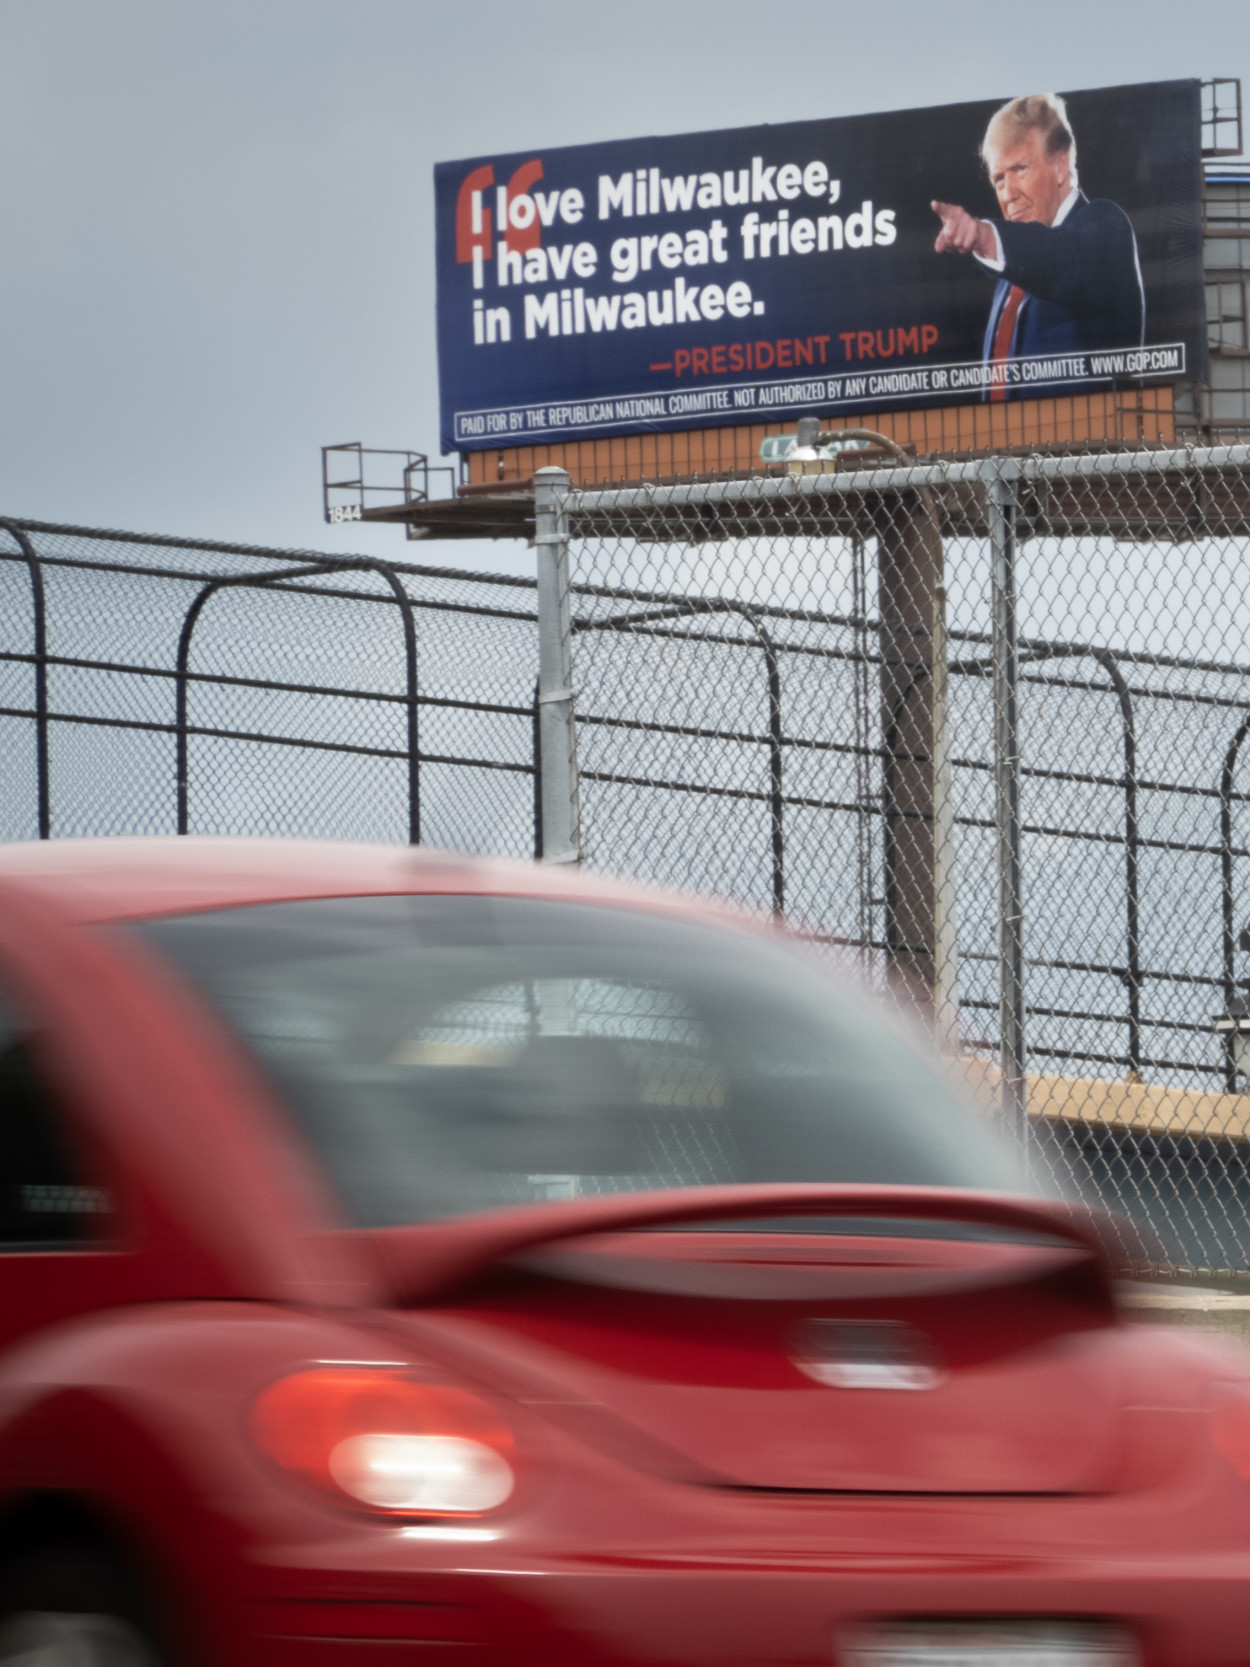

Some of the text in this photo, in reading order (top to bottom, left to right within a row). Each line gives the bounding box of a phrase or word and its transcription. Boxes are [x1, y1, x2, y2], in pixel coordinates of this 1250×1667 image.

[471, 156, 841, 235] I love Milwaukee,
[472, 200, 898, 290] I have great friends
[473, 277, 765, 345] in Milwaukee.
[838, 324, 939, 362] TRUMP
[460, 350, 1179, 435] PAID FOR BY THE REPUBLICAN NATIONAL COMMITTEE. NOT AUTHORIZED BY ANY CANDIDATE OR CANDIDATE'S COMMITTEE. WWW.GOP.COM
[328, 504, 362, 524] 1844
